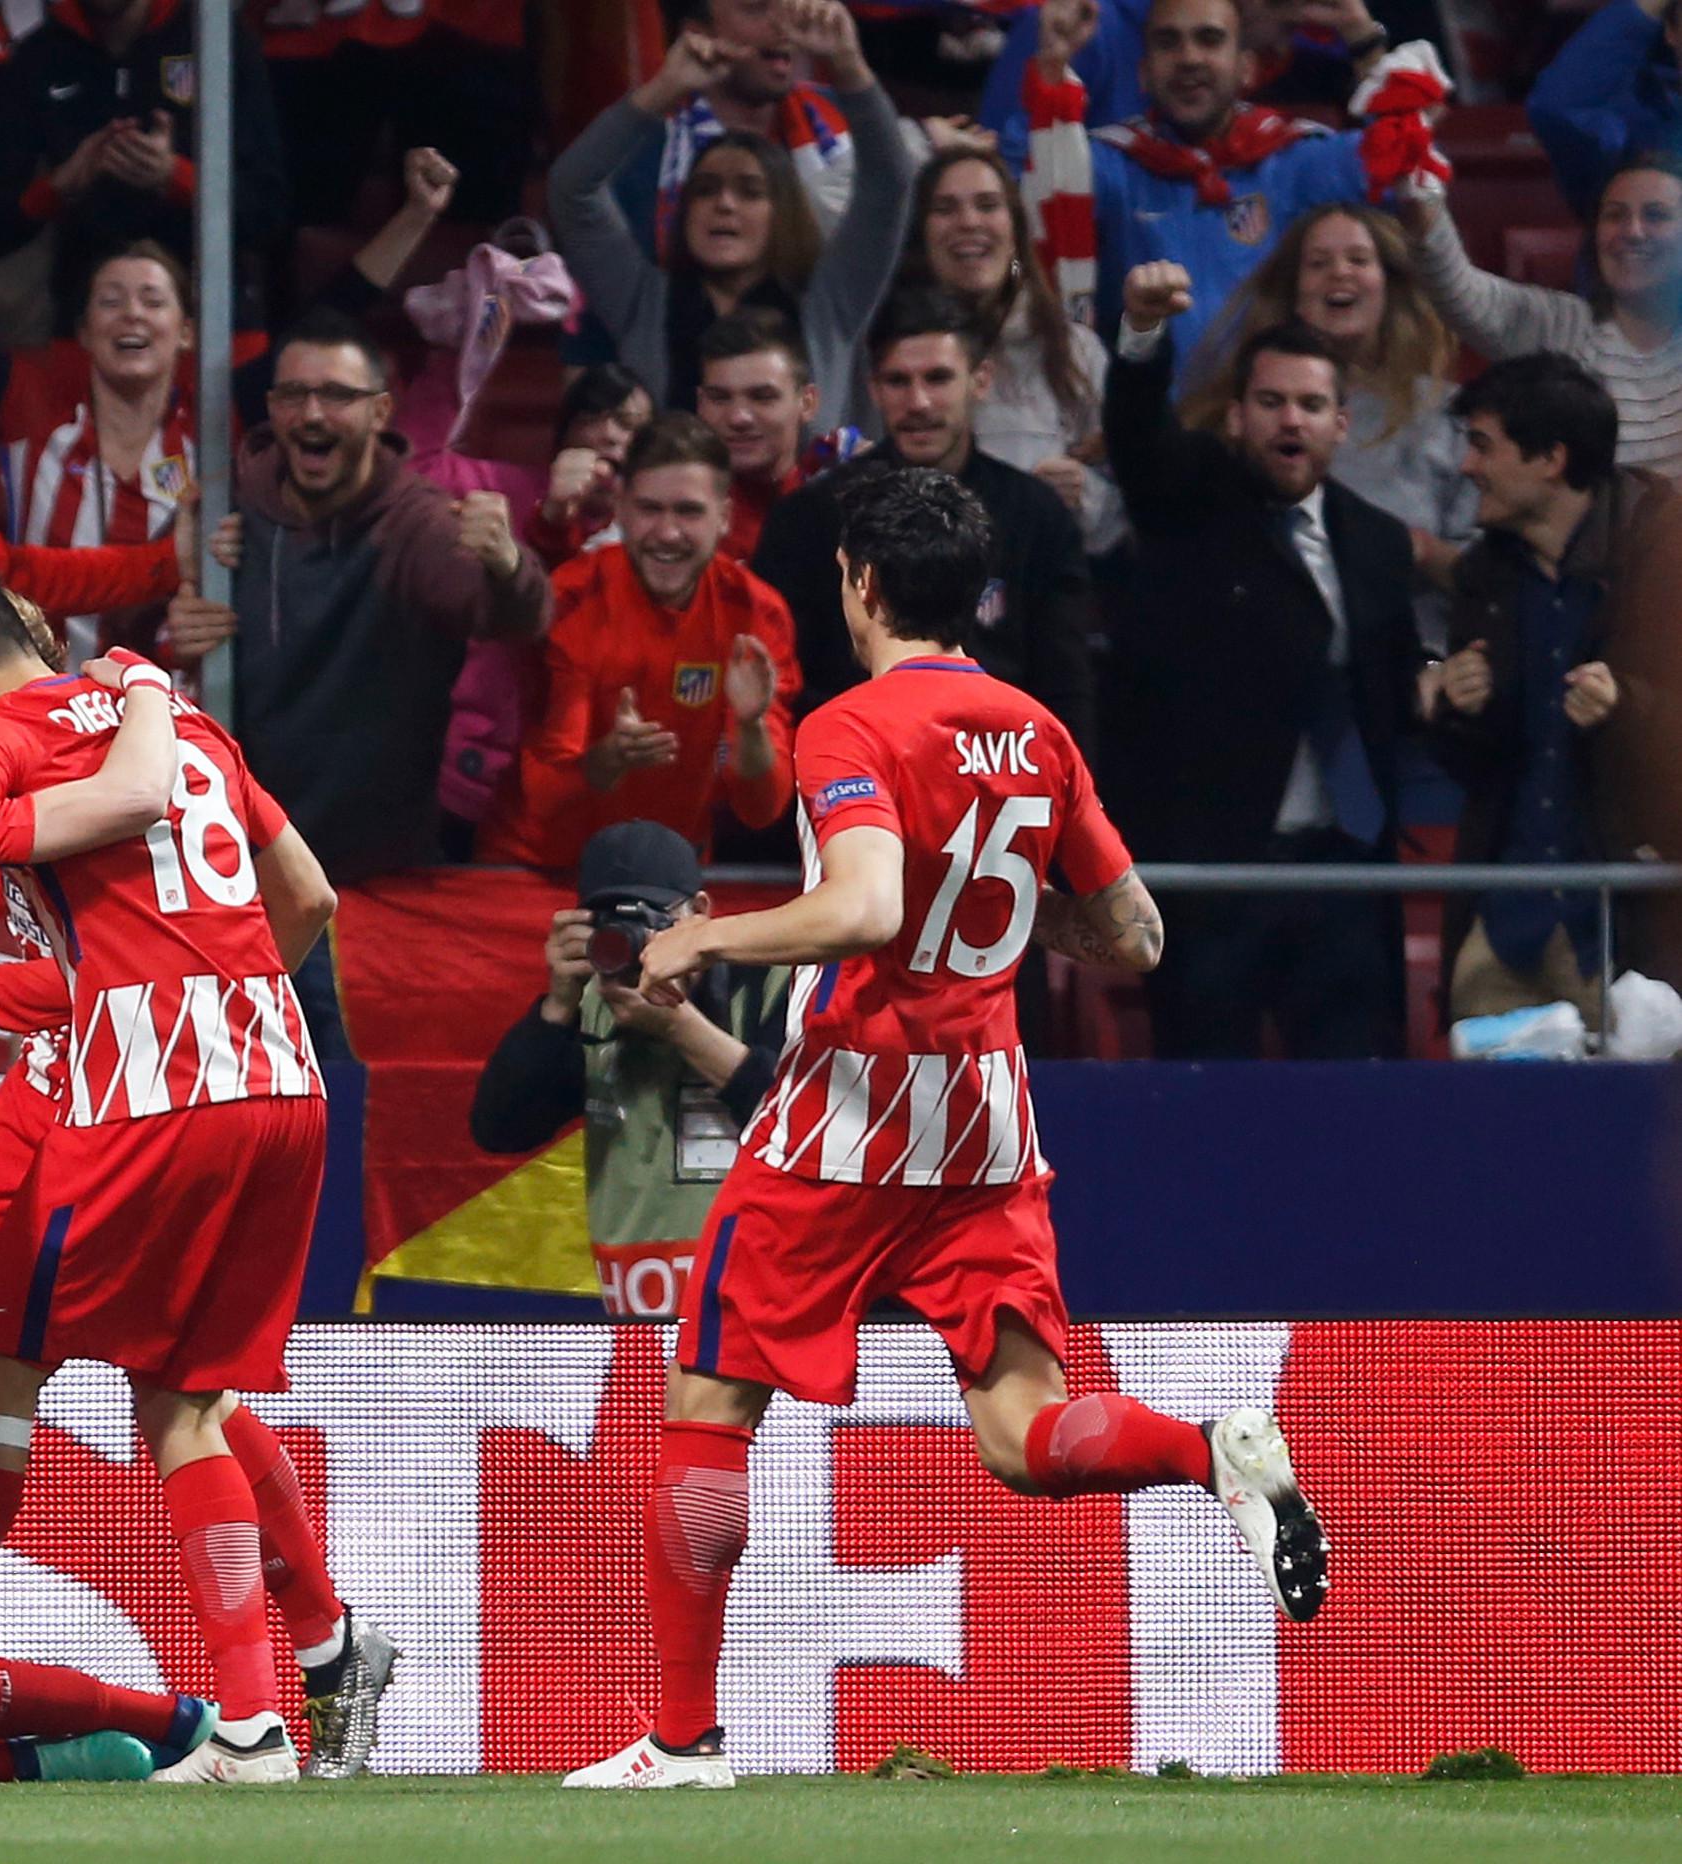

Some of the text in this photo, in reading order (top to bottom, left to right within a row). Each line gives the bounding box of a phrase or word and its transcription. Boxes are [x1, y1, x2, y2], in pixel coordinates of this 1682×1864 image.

[954, 721, 1039, 775] SAVIĆ
[145, 739, 258, 913] 18
[908, 796, 1053, 977] 15
[618, 1766, 665, 1788] adidas
